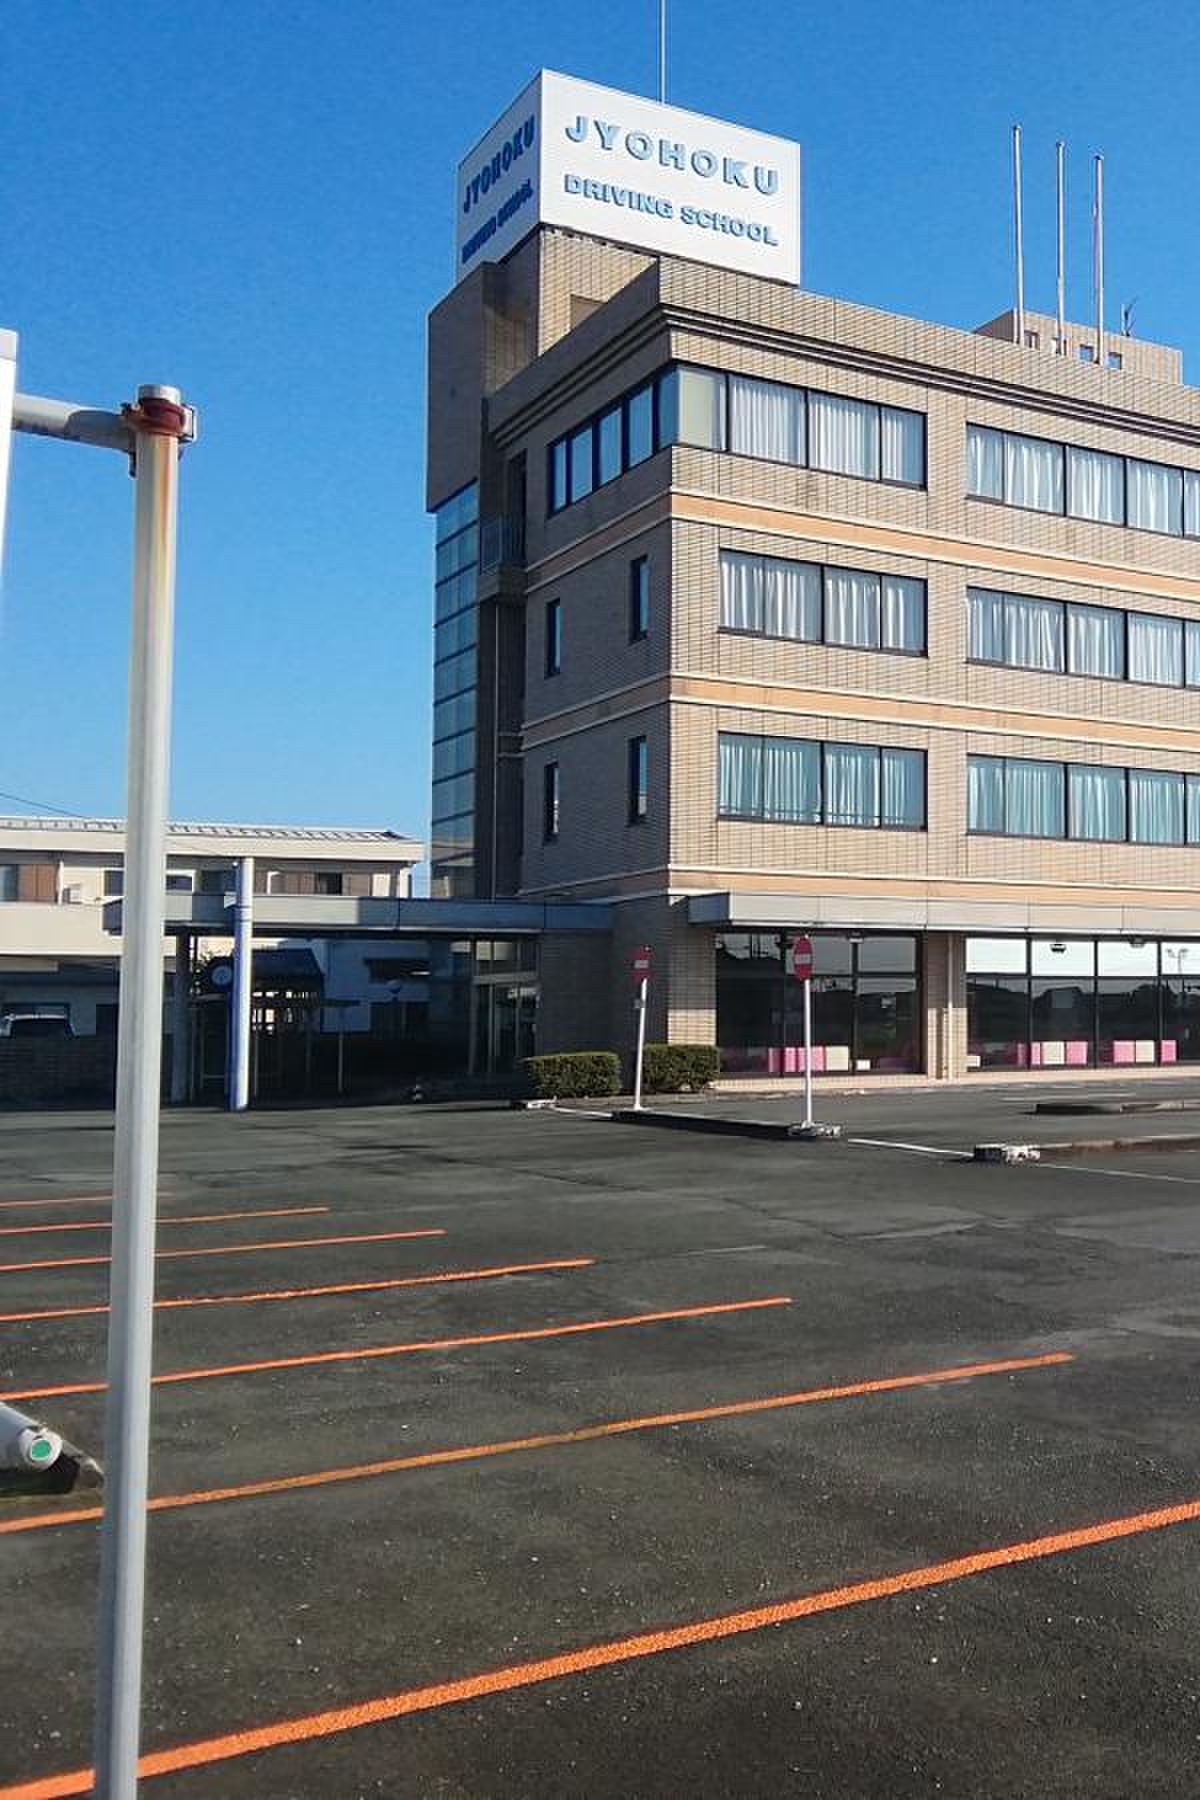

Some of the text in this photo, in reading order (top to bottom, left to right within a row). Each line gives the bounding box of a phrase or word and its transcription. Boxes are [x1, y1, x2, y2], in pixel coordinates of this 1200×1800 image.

[565, 116, 779, 195] JYOHOKU
[564, 174, 779, 246] DRIVING SCHOOL
